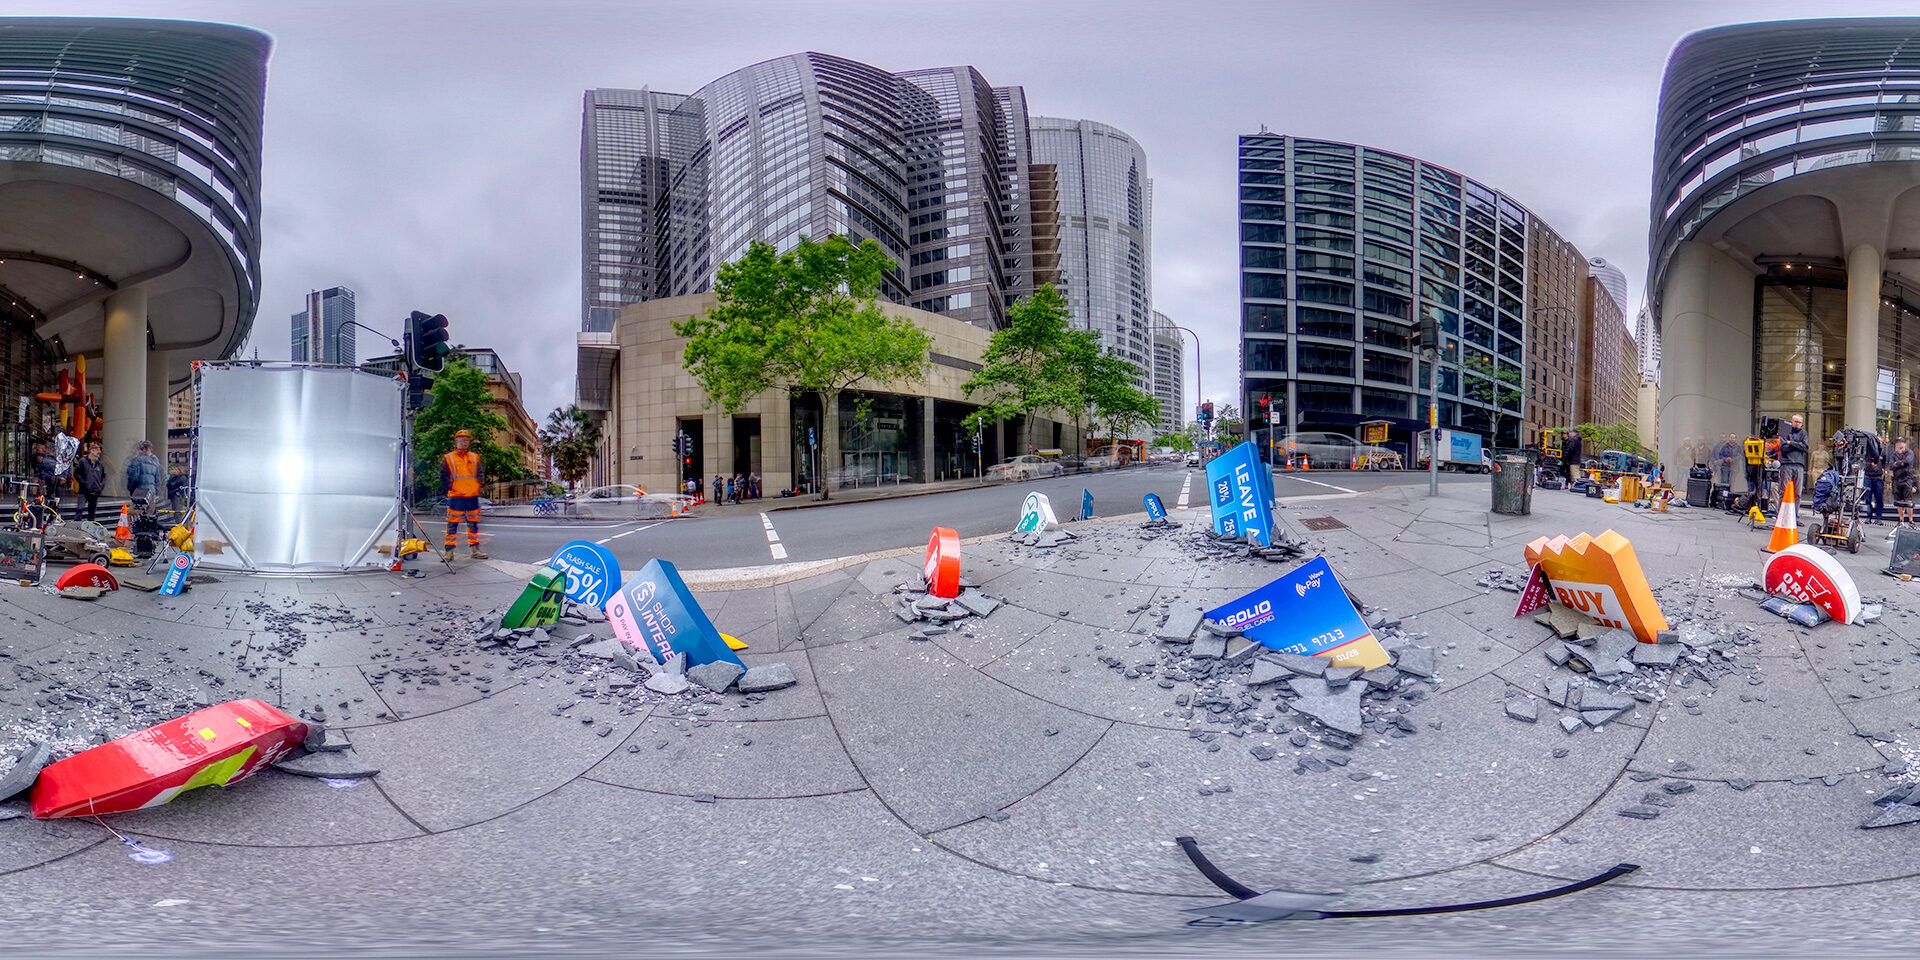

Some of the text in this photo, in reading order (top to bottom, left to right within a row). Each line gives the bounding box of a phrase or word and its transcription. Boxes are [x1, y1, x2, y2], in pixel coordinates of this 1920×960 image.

[1218, 481, 1230, 502] 20%
[1234, 463, 1257, 522] LEAVE
[1147, 498, 1160, 516] APPLY
[566, 553, 601, 575] FLASH SALE
[165, 570, 182, 595] & SAVE
[1305, 577, 1321, 591] Pay
[1309, 570, 1325, 582] Wave
[1783, 572, 1811, 602] ORD
[1555, 586, 1606, 615] BUY
[536, 606, 556, 619] GUAC
[652, 601, 676, 635] SHOP
[1254, 614, 1275, 628] CARD
[620, 618, 628, 632] PAY
[626, 632, 632, 641] IN
[1312, 628, 1345, 648] 9713
[1336, 648, 1360, 662] 01/28
